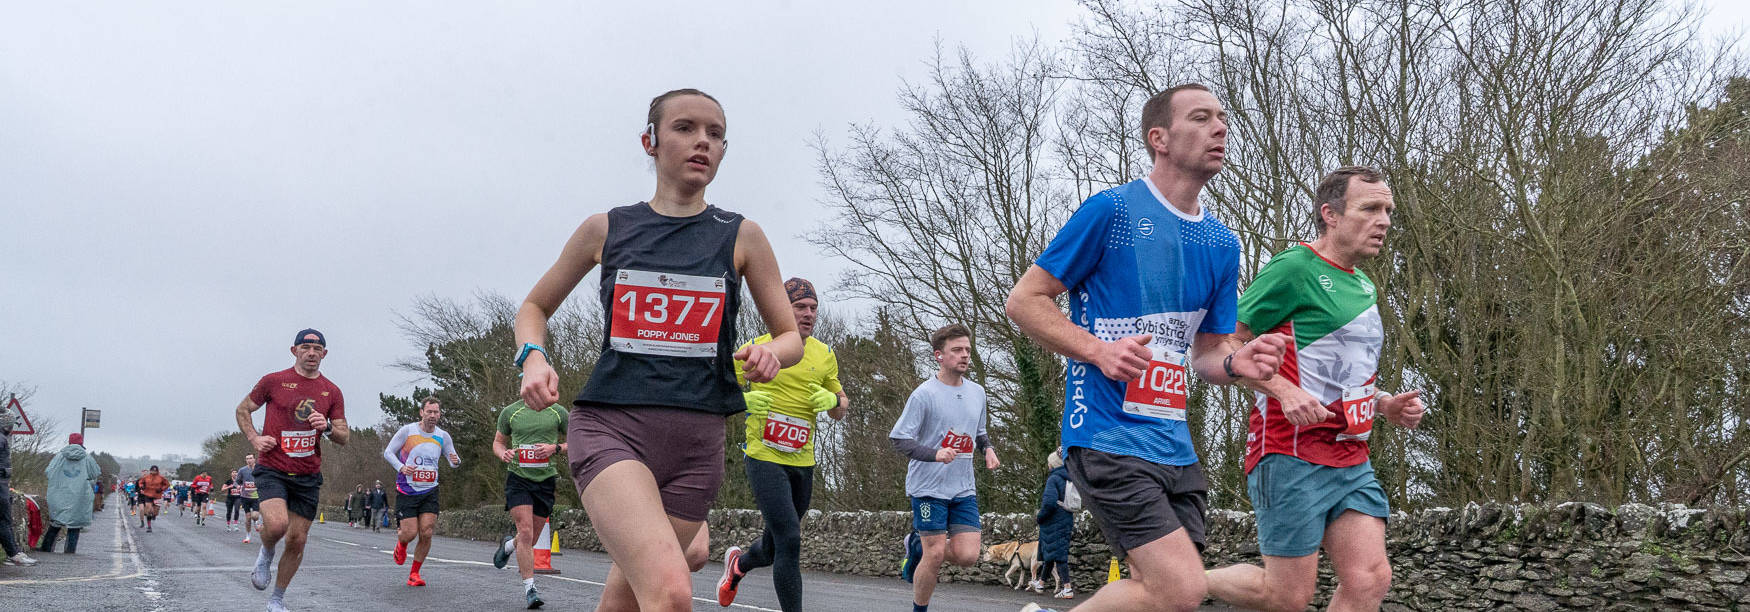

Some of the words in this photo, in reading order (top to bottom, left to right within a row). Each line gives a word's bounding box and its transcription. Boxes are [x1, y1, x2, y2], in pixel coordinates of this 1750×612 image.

[619, 290, 721, 327] 1377
[637, 329, 668, 340] POPPY
[669, 332, 700, 342] JONES
[767, 422, 809, 443] 1706
[283, 436, 316, 449] 1768
[413, 470, 435, 480] 1631
